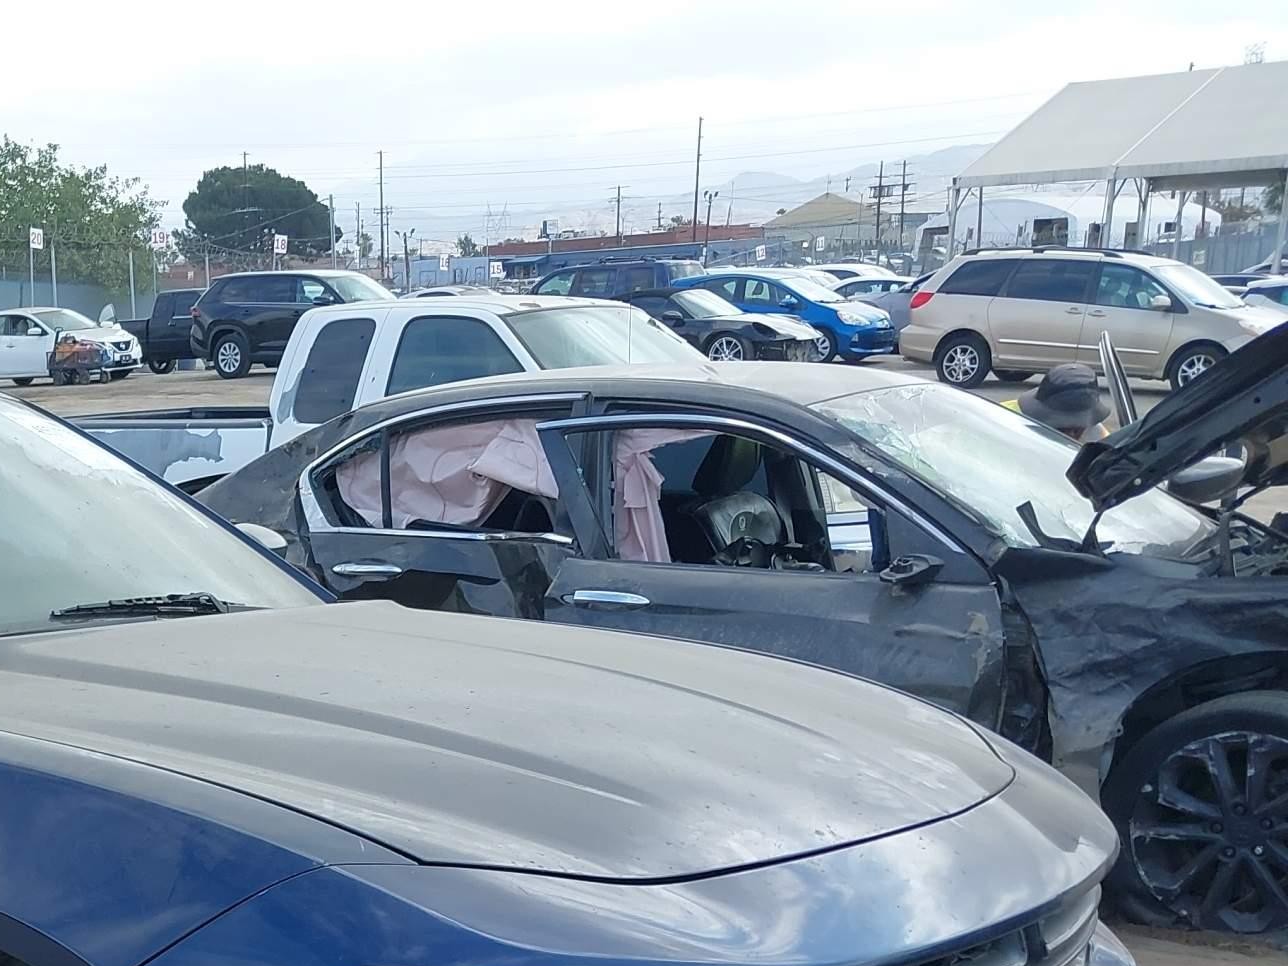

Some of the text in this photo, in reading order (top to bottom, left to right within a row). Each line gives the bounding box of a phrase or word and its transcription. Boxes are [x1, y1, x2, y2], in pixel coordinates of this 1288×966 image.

[31, 231, 42, 245] 20
[152, 231, 165, 244] 19
[275, 238, 286, 250] 18
[491, 264, 502, 275] 15
